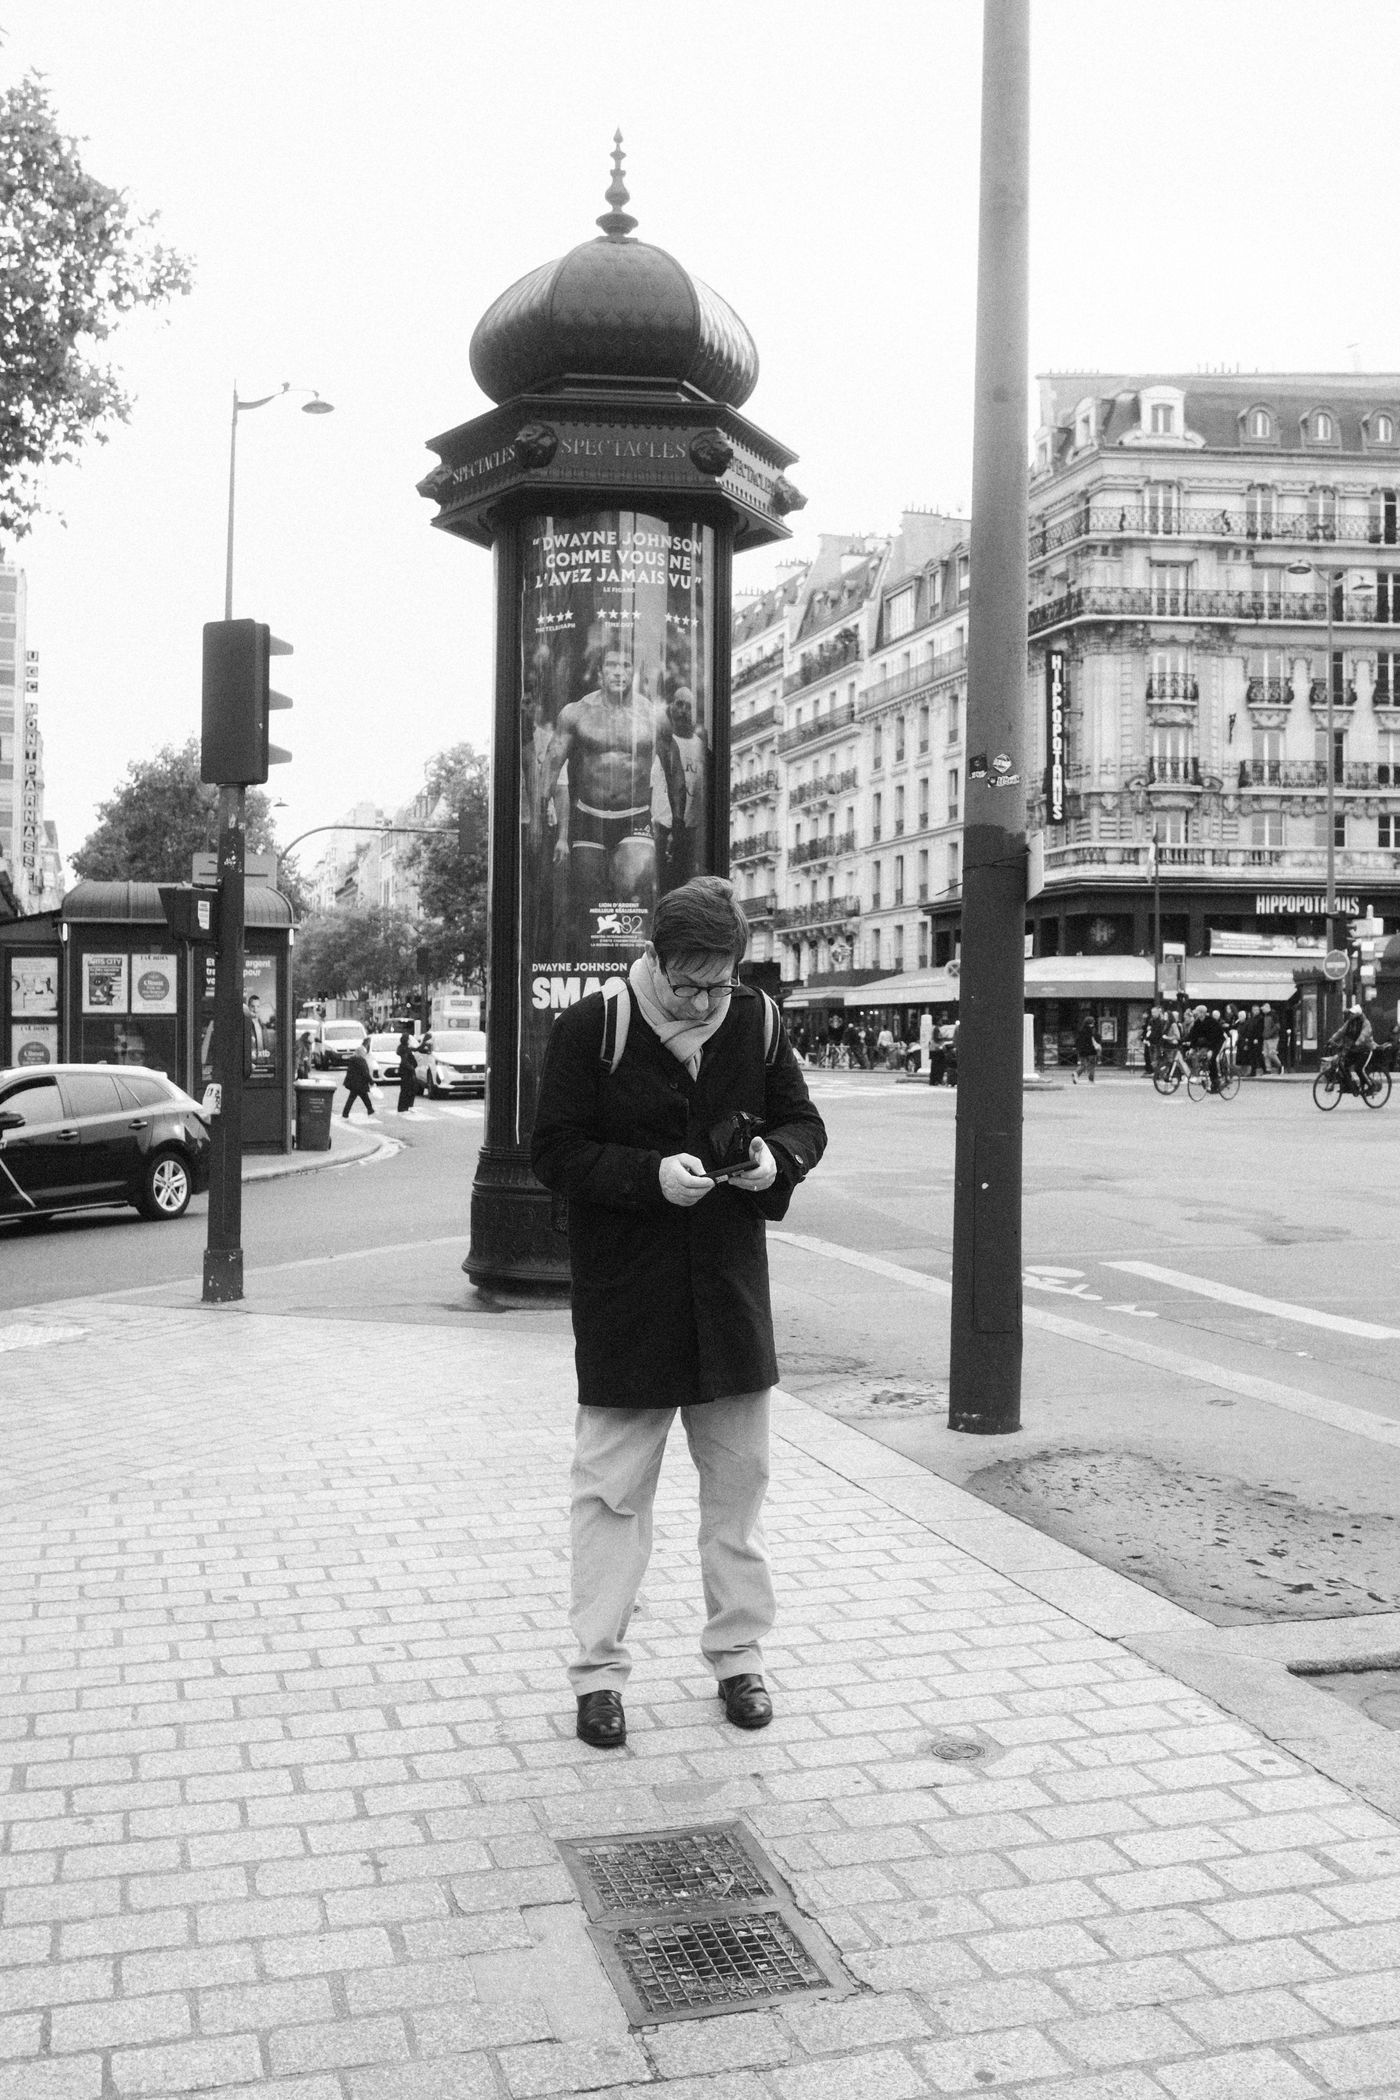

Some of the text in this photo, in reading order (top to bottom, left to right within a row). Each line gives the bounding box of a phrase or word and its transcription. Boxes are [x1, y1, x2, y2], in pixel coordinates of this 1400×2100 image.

[560, 438, 687, 458] SPECTACLES
[622, 532, 702, 555] JOHNSON
[545, 549, 691, 571] COMME VOUS NE
[535, 568, 592, 589] L'AVEZ
[597, 568, 665, 585] JAMAIS
[1052, 655, 1063, 821] HIPPOPOTAMUS
[621, 915, 643, 934] 82
[532, 962, 628, 972] DWAYNE JOHNSON
